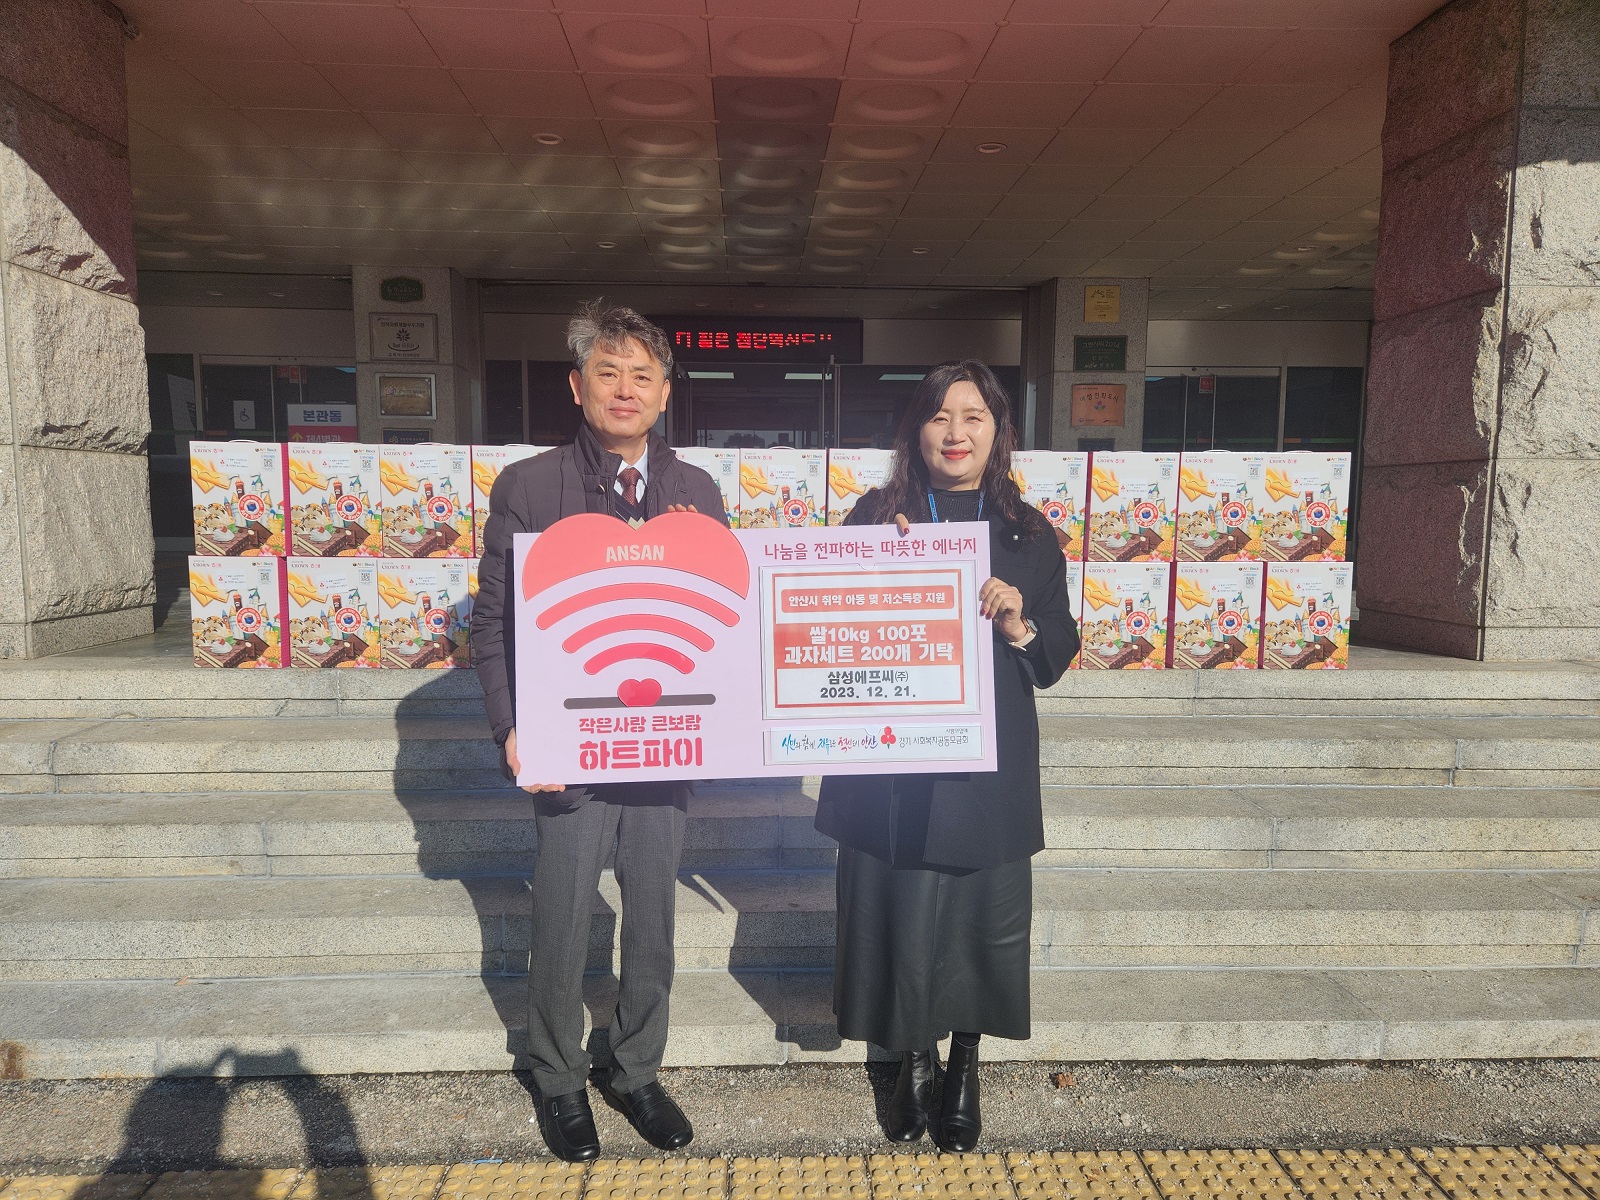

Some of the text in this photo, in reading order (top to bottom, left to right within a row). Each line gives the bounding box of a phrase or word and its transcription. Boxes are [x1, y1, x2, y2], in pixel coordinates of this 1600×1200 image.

[303, 410, 342, 422] 본관동
[606, 544, 664, 563] ANSAN
[764, 538, 977, 560] 나눔을 전파하는 따뜻한 에너지
[788, 594, 818, 607] 안산시
[822, 594, 842, 606] 취약
[845, 593, 865, 606] 아동
[868, 593, 879, 606] 및
[925, 592, 946, 604] 지원
[810, 624, 927, 646] 쌀10kg 100포
[784, 642, 954, 665] 과자세트 200개 기탁
[820, 686, 916, 699] 2023. 12. 21.
[578, 714, 702, 735] 작은사랑 큰보람
[782, 734, 802, 755] 시민과
[861, 735, 879, 750] 안산
[898, 736, 968, 748] 경기 사회복지공동모금회
[579, 737, 703, 770] 하트파이
